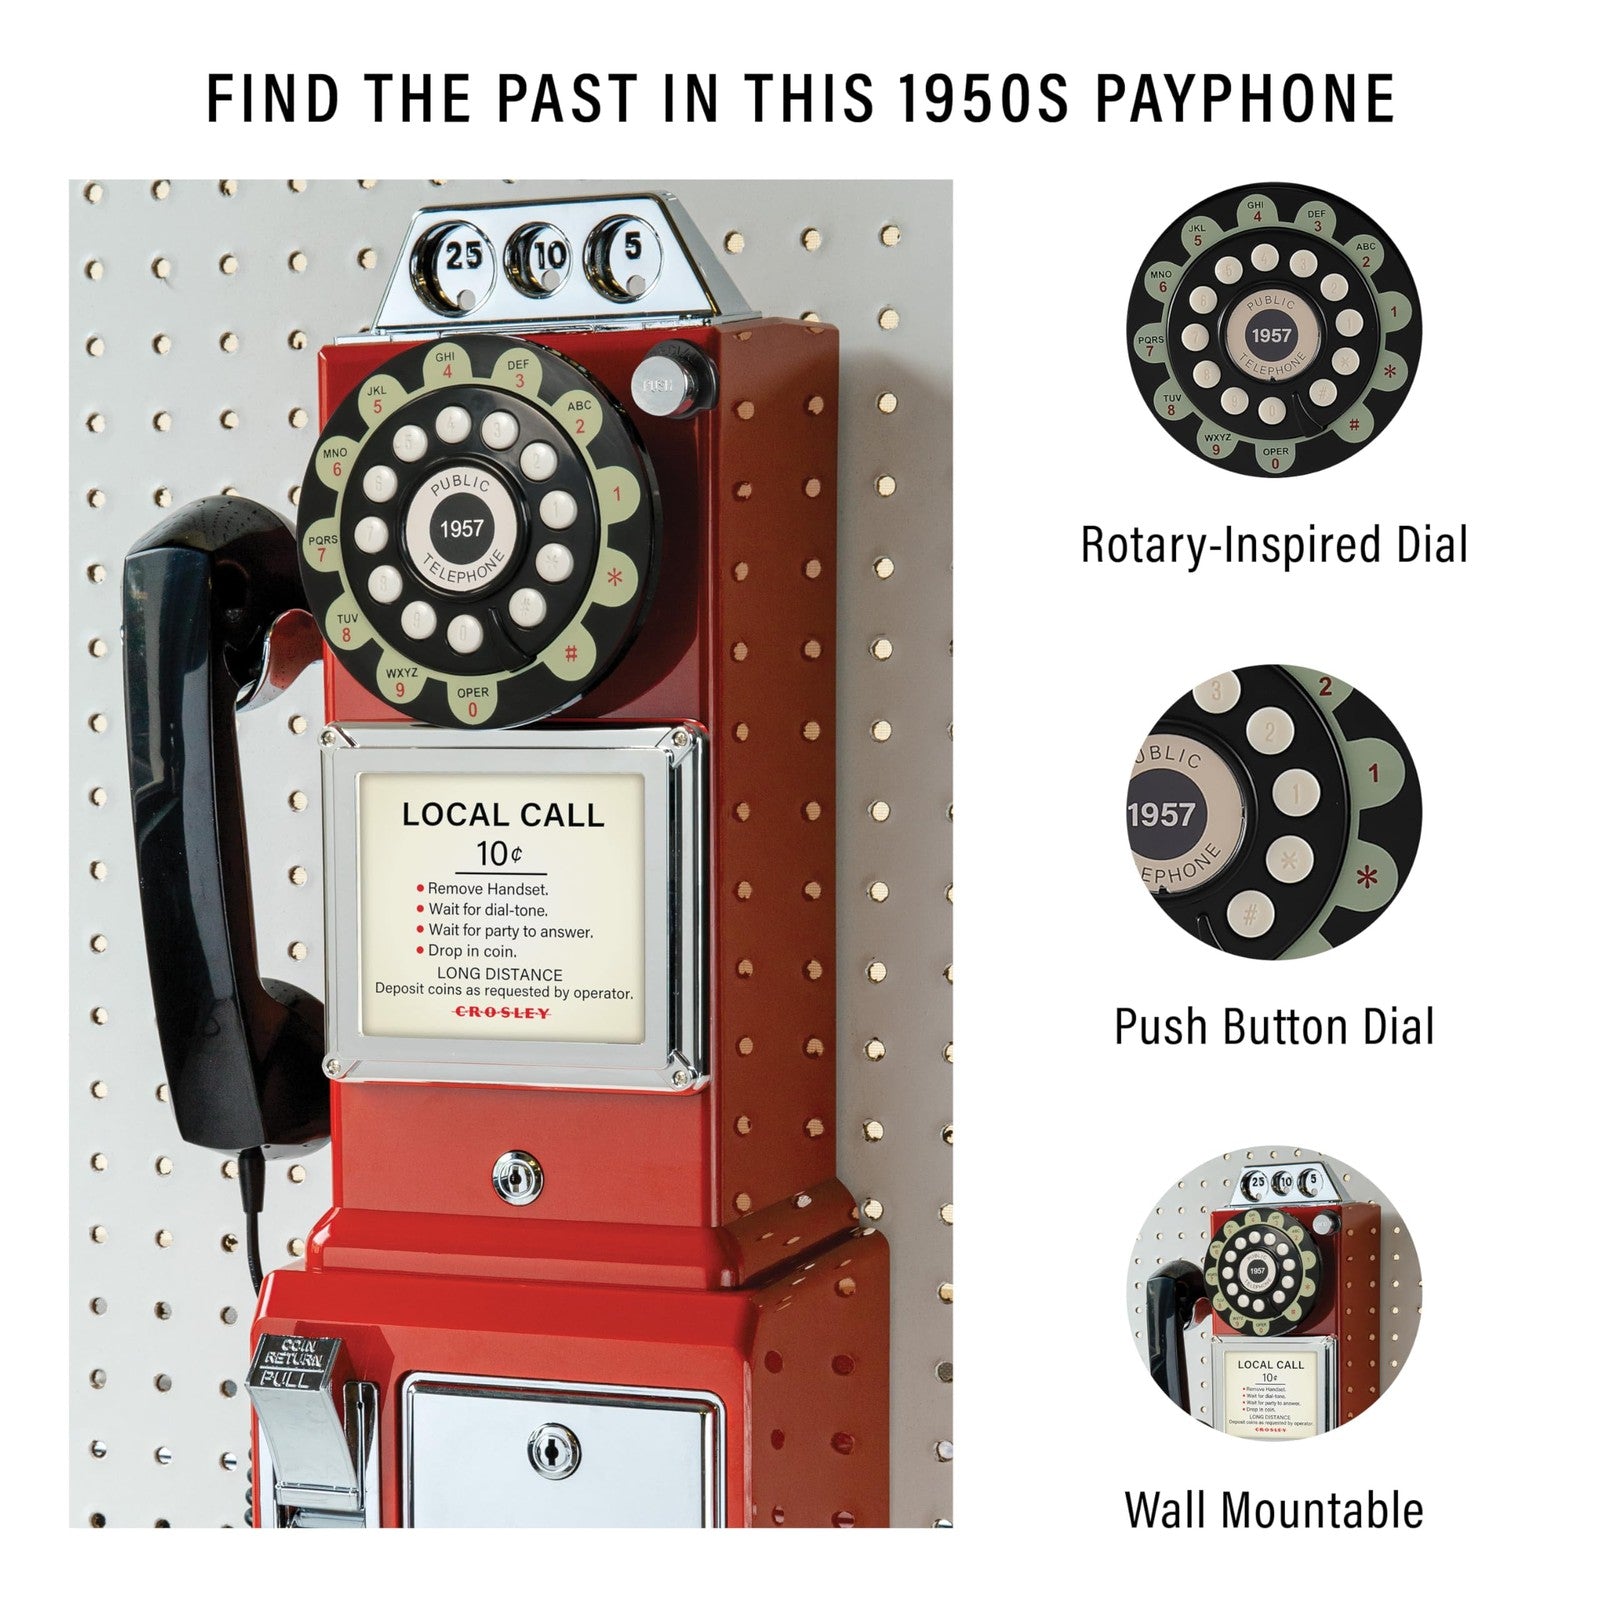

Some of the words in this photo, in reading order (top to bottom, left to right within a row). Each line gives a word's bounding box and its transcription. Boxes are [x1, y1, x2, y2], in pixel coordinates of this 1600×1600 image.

[1248, 201, 1264, 209] GHI
[1254, 212, 1262, 222] 4
[1308, 210, 1326, 218] DEF
[1189, 224, 1206, 232] JKL
[1314, 221, 1322, 231] 3
[1194, 236, 1202, 246] 5
[1356, 242, 1376, 250] ABC
[446, 241, 482, 269] 25
[534, 240, 567, 269] 10
[624, 232, 642, 259] 5
[1363, 257, 1370, 267] 2
[1151, 270, 1172, 278] MNO
[1160, 282, 1167, 292] 6
[1247, 296, 1296, 310] PUBLIC
[1391, 306, 1397, 316] 1
[1138, 336, 1164, 345] PQRS
[1252, 328, 1292, 343] 1957
[436, 352, 455, 362] GHI
[1146, 346, 1153, 356] 7
[508, 359, 530, 370] DEF
[1238, 352, 1307, 375] TELEPHONE
[443, 365, 452, 378] 4
[516, 374, 524, 388] 3
[367, 386, 386, 396] JKL
[1164, 394, 1182, 402] TUV
[373, 400, 382, 413] 5
[568, 399, 591, 411] ABC
[1168, 405, 1175, 415] 8
[576, 419, 584, 433] 2
[1350, 419, 1360, 430] #
[1204, 434, 1231, 442] WXYZ
[323, 447, 347, 458] MNO
[1212, 444, 1220, 454] 9
[1263, 448, 1288, 456] OPER
[333, 463, 342, 476] 6
[1272, 458, 1279, 469] 0
[430, 474, 490, 497] PUBLIC
[614, 487, 619, 500] 1
[440, 519, 484, 538] 1957
[308, 534, 338, 545] PQRS
[318, 548, 326, 562] 7
[424, 549, 505, 584] TELEPHONE
[337, 614, 358, 624] TUV
[343, 628, 351, 642] 8
[565, 645, 577, 661] #
[386, 668, 418, 678] WXYZ
[396, 683, 404, 697] 9
[457, 687, 489, 698] OPER
[1211, 681, 1220, 700] 3
[1319, 677, 1332, 696] 2
[468, 703, 477, 716] 0
[1265, 722, 1275, 741] 2
[1369, 763, 1378, 782] 1
[403, 802, 510, 827] LOCAL
[521, 803, 605, 827] CALL
[1128, 803, 1196, 827] 1957
[477, 841, 522, 866] 10¢
[428, 883, 483, 895] Remove
[488, 883, 549, 896] Handset.
[429, 904, 459, 916] Wait
[463, 904, 481, 916] for
[485, 904, 548, 917] dial-tone.
[429, 924, 459, 936] Wait
[463, 924, 481, 936] for
[485, 925, 519, 940] party
[523, 926, 536, 937] to
[540, 927, 593, 939] answer.
[429, 945, 462, 960] Drop
[468, 945, 479, 957] in
[484, 946, 517, 958] coin.
[438, 967, 480, 980] LONG
[486, 968, 563, 982] DISTANCE
[375, 982, 424, 996] Deposit
[428, 984, 461, 996] coins
[466, 986, 480, 996] as
[485, 985, 550, 998] requested
[555, 986, 569, 1000] by
[573, 988, 633, 1001] operator.
[452, 1006, 552, 1019] CROSLEY
[1252, 1177, 1264, 1186] 25
[1281, 1177, 1291, 1186] 10
[1311, 1174, 1316, 1183] 5
[1238, 1361, 1273, 1369] LOCAL
[1277, 1361, 1304, 1369] CALL
[260, 1370, 309, 1389] PULL
